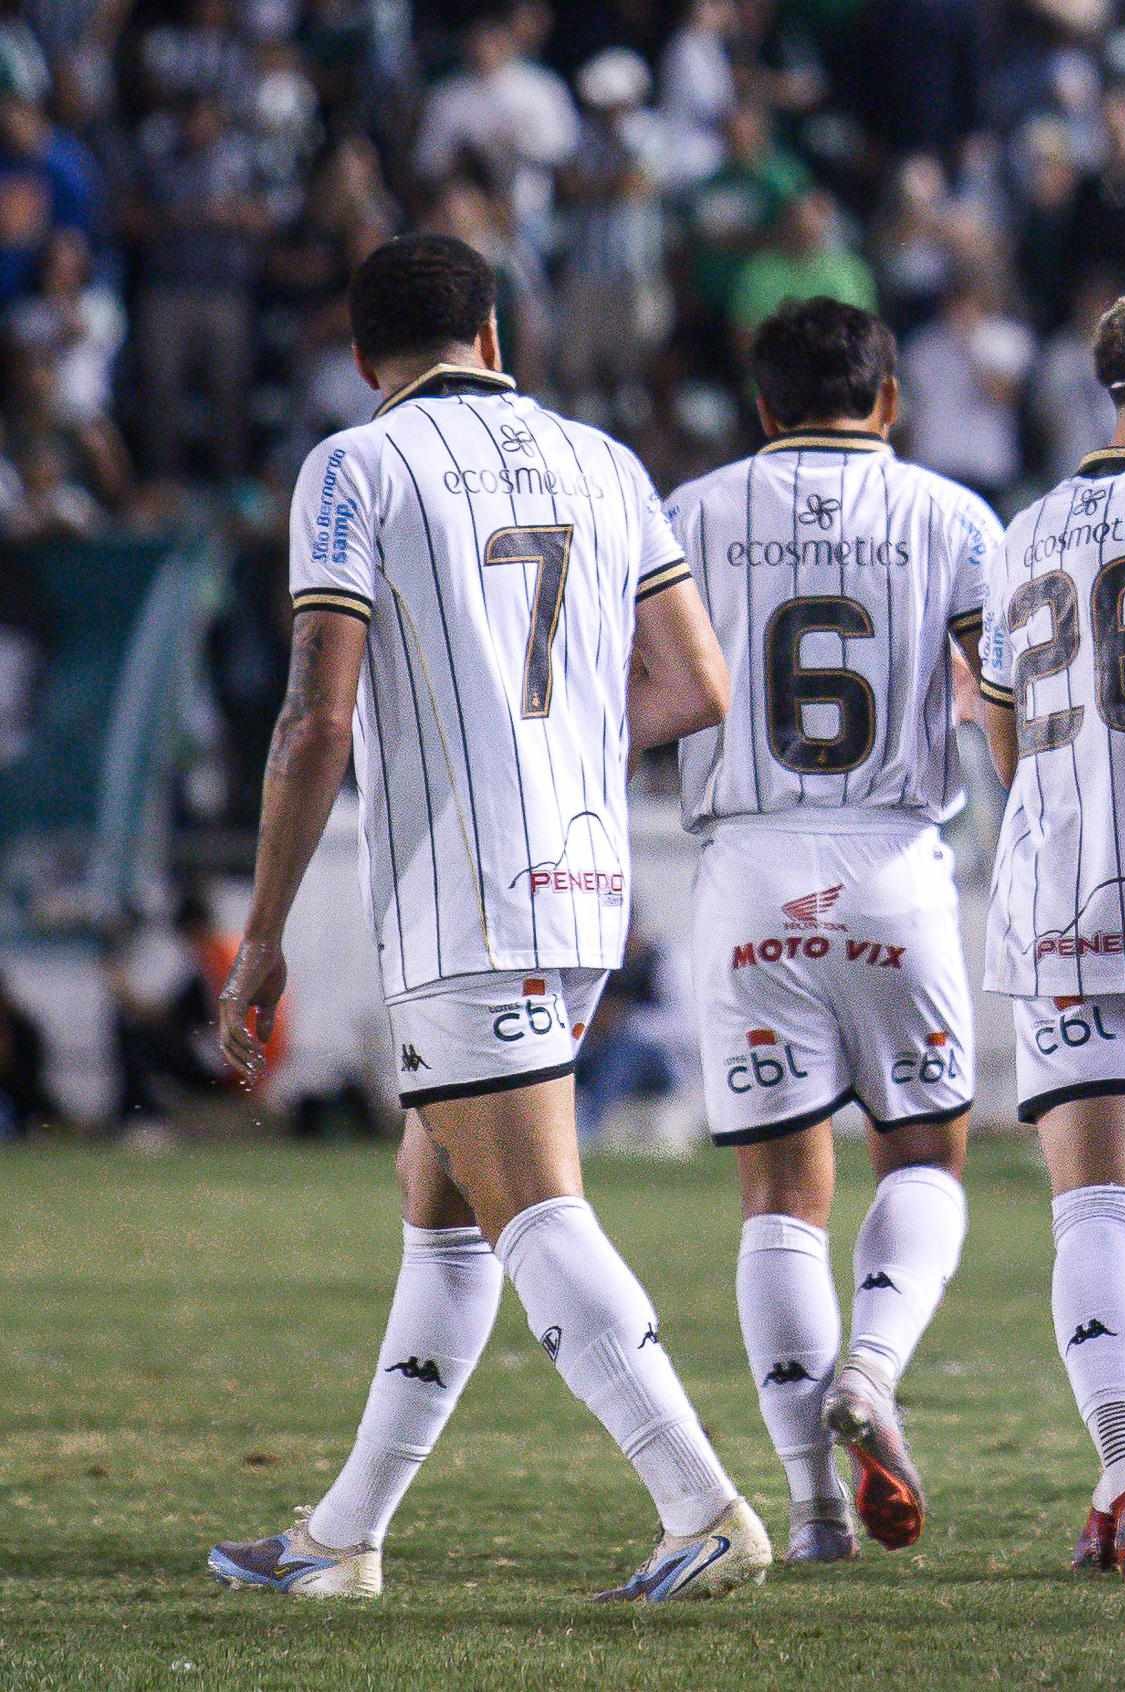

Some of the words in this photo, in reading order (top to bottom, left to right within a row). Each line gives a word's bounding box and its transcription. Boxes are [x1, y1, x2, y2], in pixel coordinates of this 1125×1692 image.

[726, 534, 910, 568] ecosmetics
[484, 523, 574, 719] 7
[763, 594, 876, 776] 6
[529, 870, 624, 896] PENEDO
[732, 936, 830, 969] MOTO
[845, 939, 906, 969] VIX
[1034, 1005, 1117, 1056] cbl
[727, 1044, 808, 1094] cbl
[891, 1048, 957, 1084] cbl
